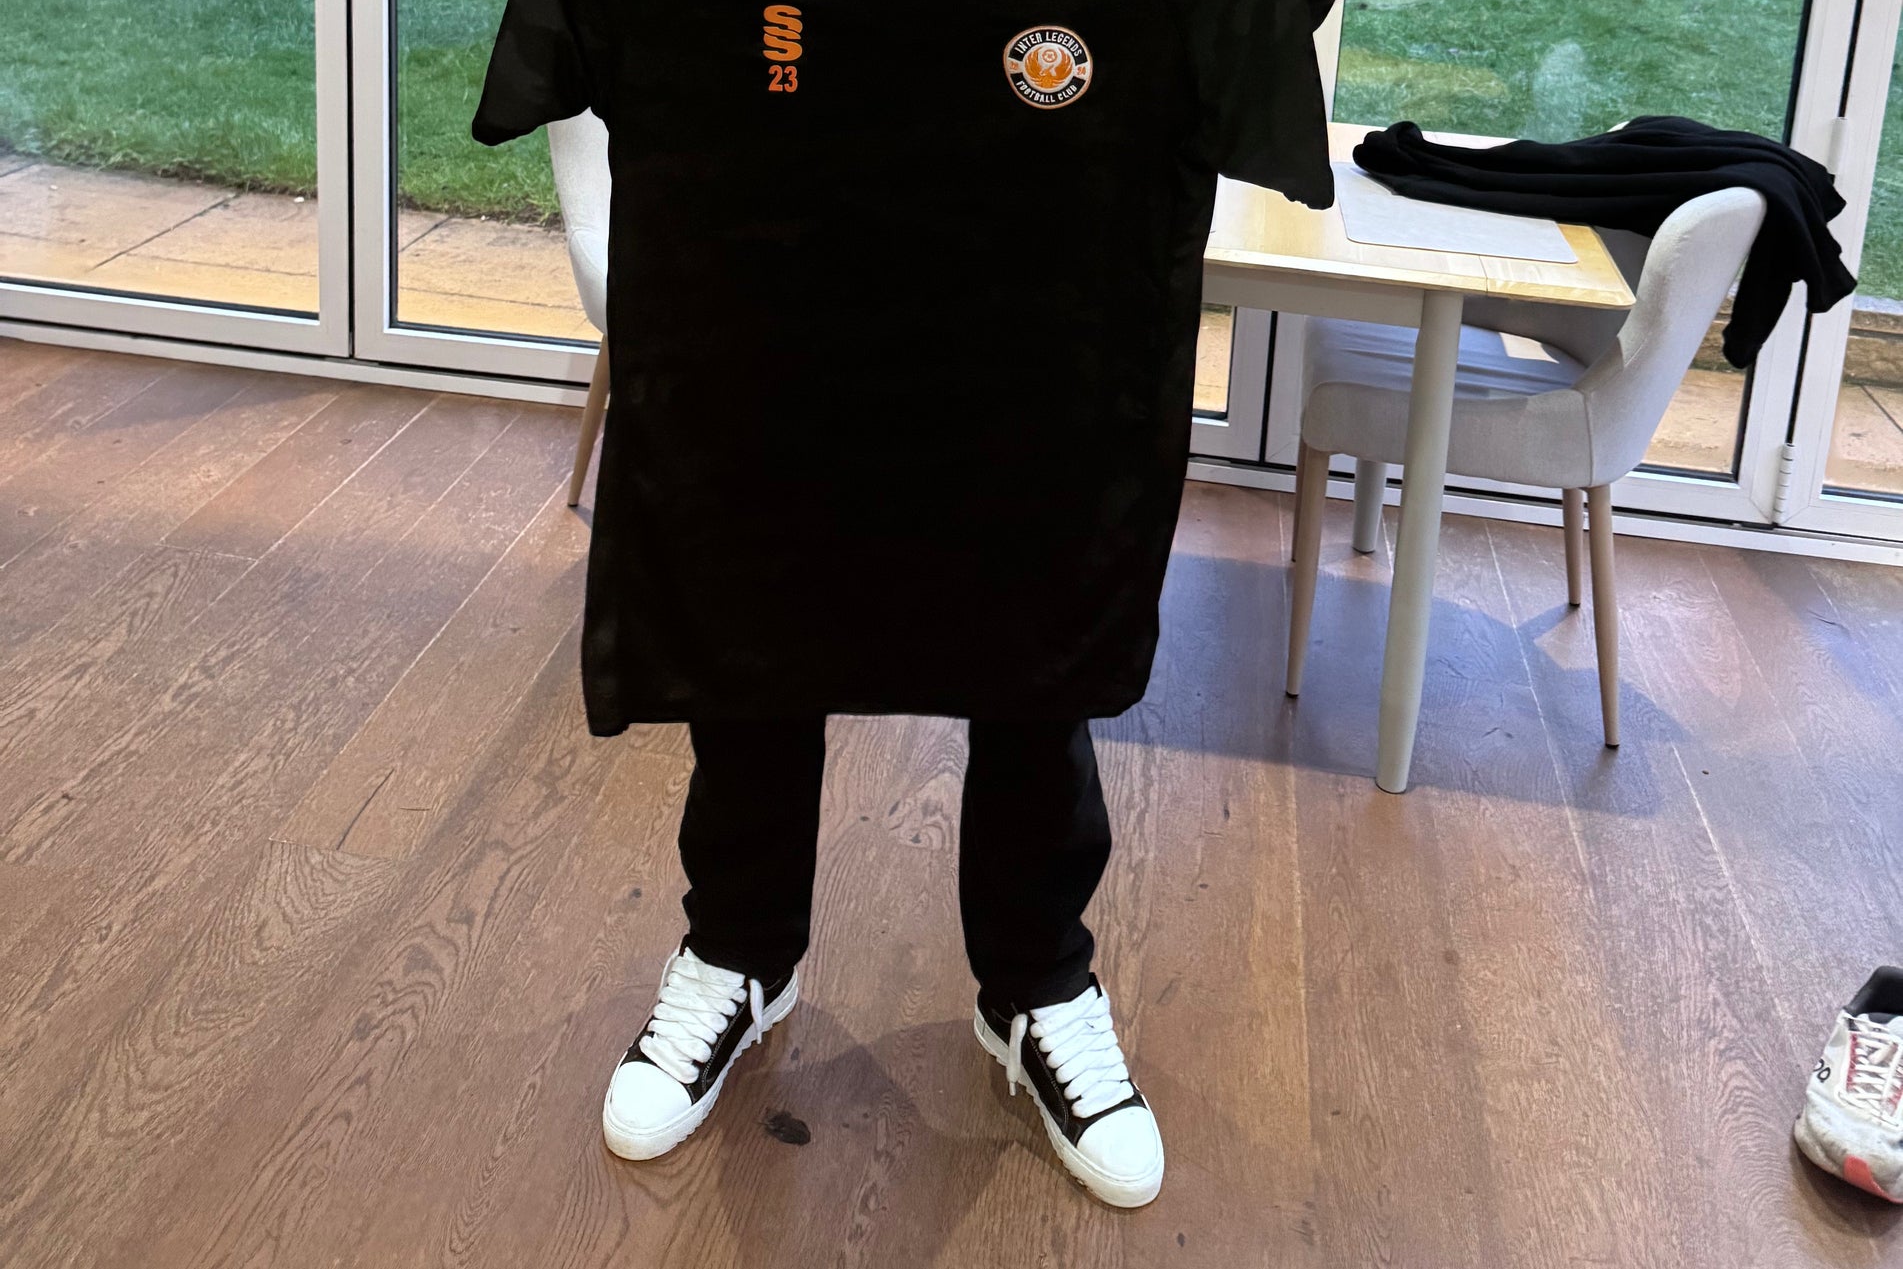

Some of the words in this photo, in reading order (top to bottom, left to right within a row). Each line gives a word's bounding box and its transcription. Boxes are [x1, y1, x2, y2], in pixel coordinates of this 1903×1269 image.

[1014, 32, 1043, 54] INTER
[1045, 31, 1083, 57] LEGENDS
[768, 64, 798, 93] 23
[1015, 80, 1056, 103] FOOTBALL
[1057, 84, 1078, 101] CLUB
